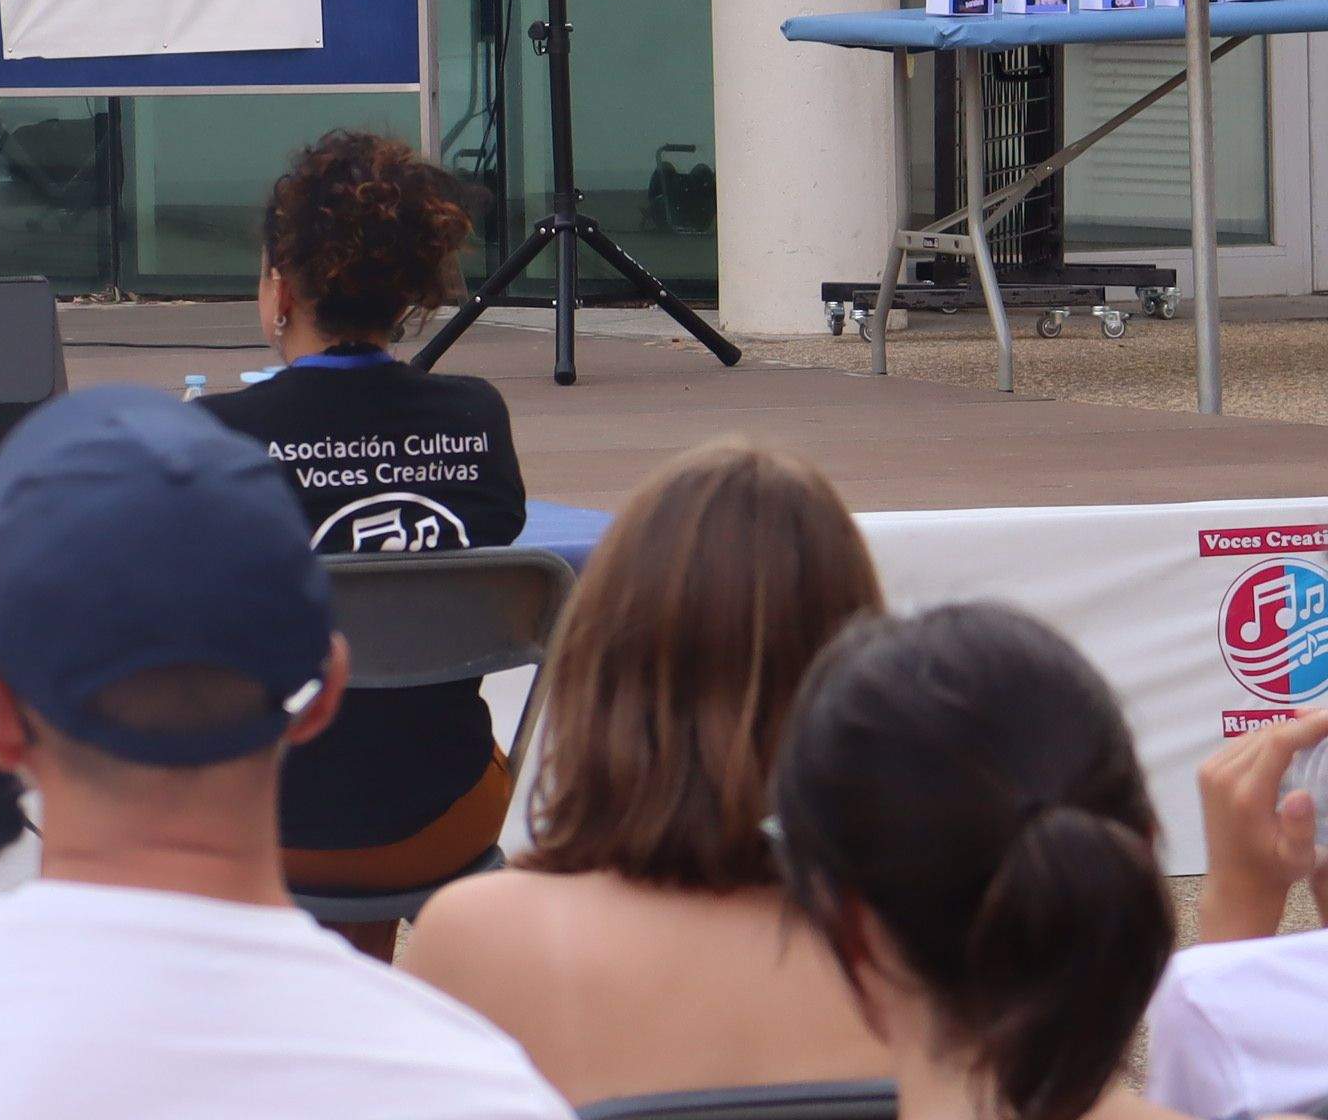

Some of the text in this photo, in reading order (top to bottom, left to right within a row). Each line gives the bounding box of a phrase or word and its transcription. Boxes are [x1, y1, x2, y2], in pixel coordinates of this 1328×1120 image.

[267, 431, 489, 462] Asociación Cultural
[296, 460, 479, 489] Voces Creativas
[1203, 533, 1262, 550] Voces
